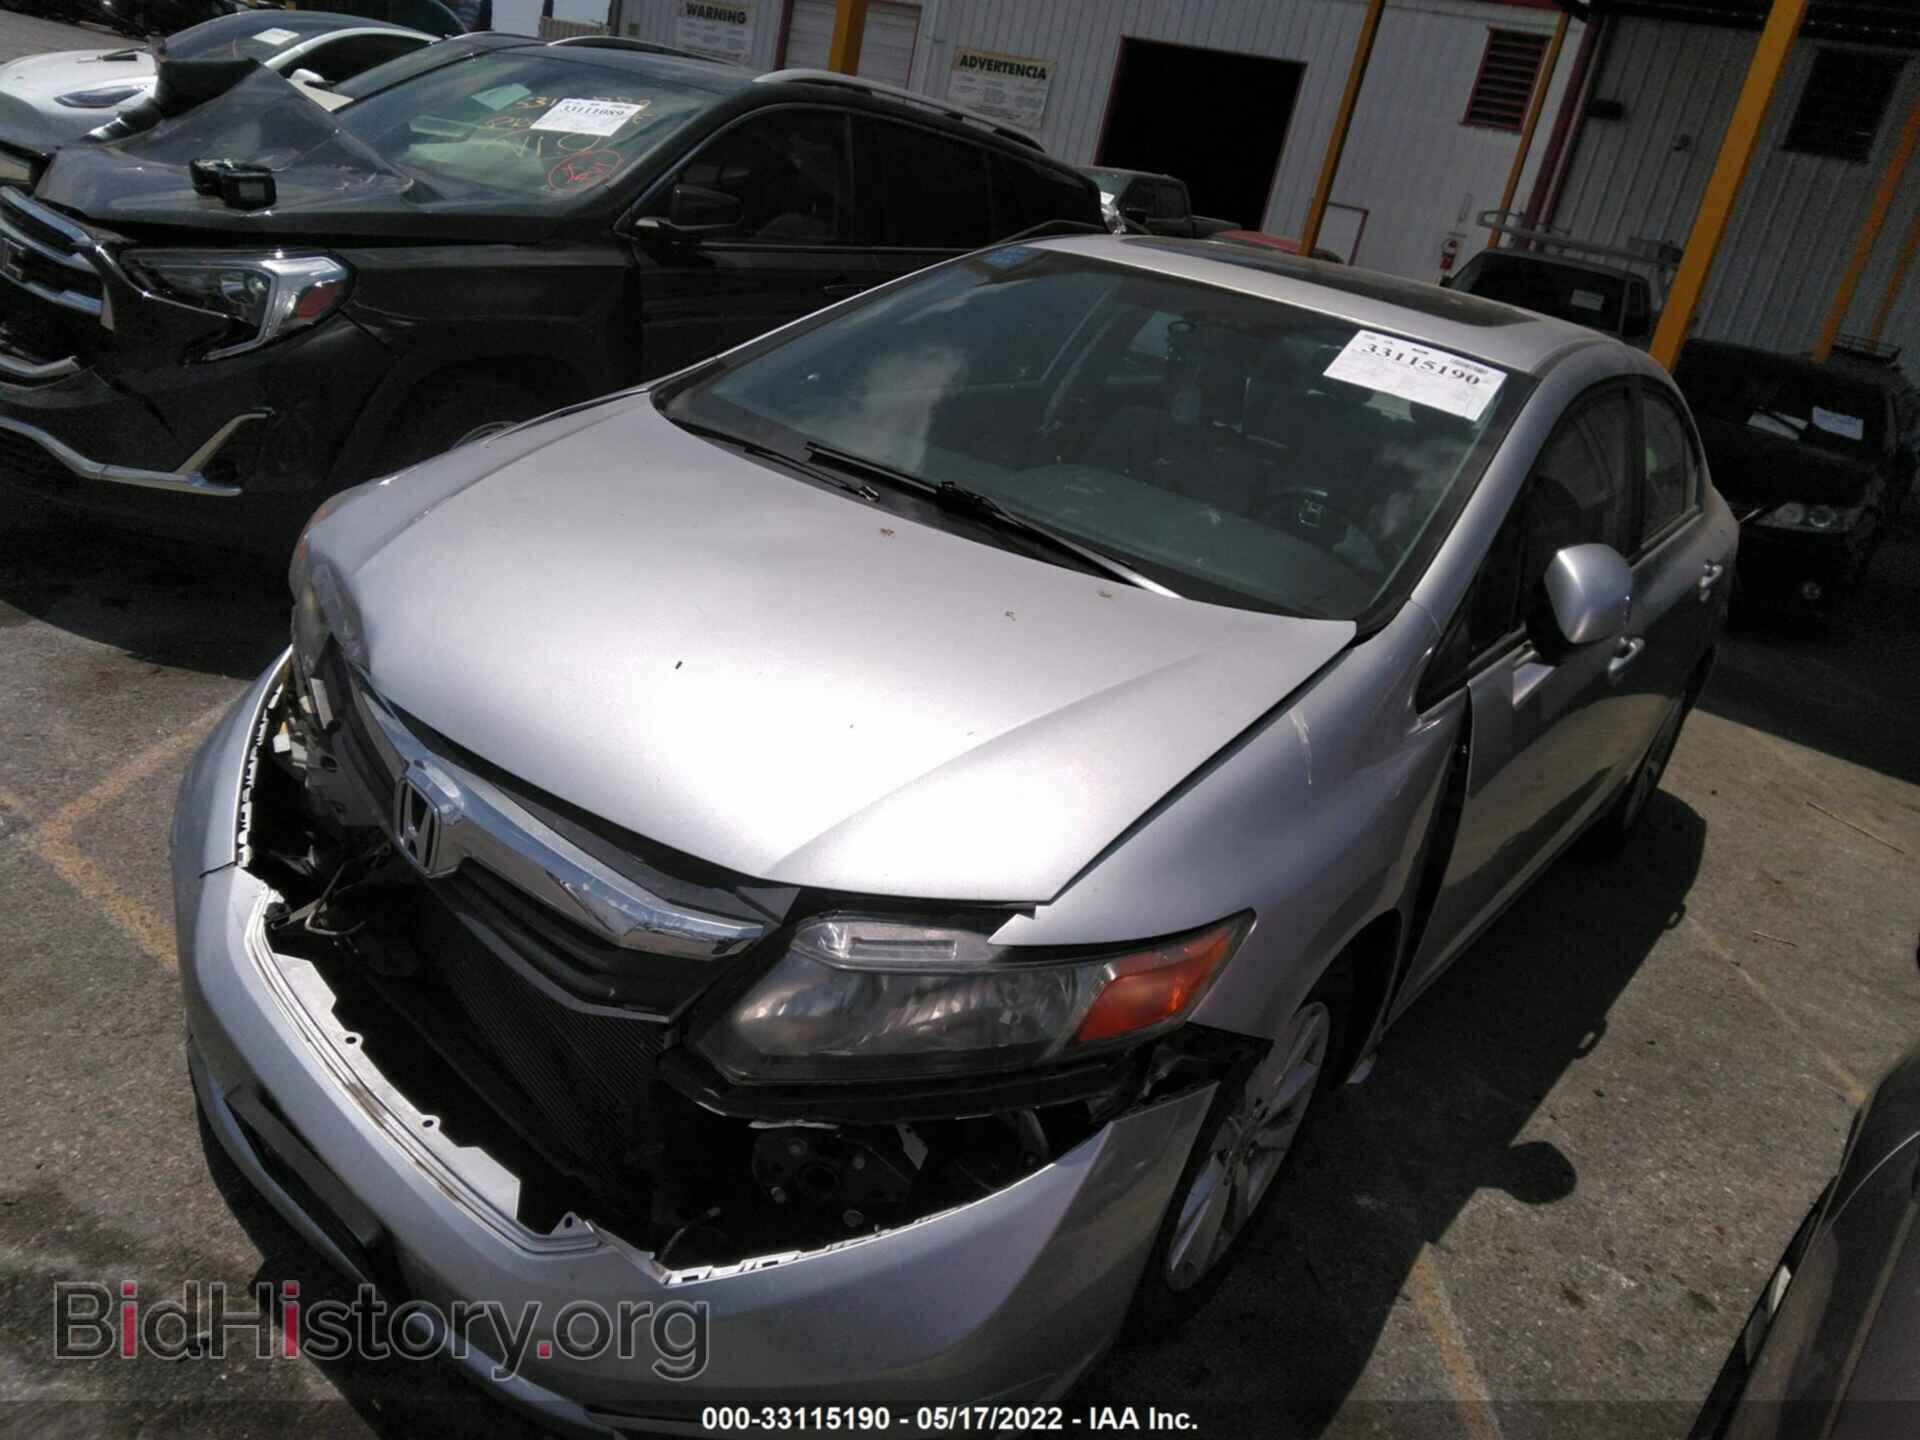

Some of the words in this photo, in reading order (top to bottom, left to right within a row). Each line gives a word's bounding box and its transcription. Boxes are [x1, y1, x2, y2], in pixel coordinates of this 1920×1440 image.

[685, 1, 747, 25] WARNING
[959, 53, 1047, 80] ADVERTENCIA
[1361, 343, 1482, 385] 33115190
